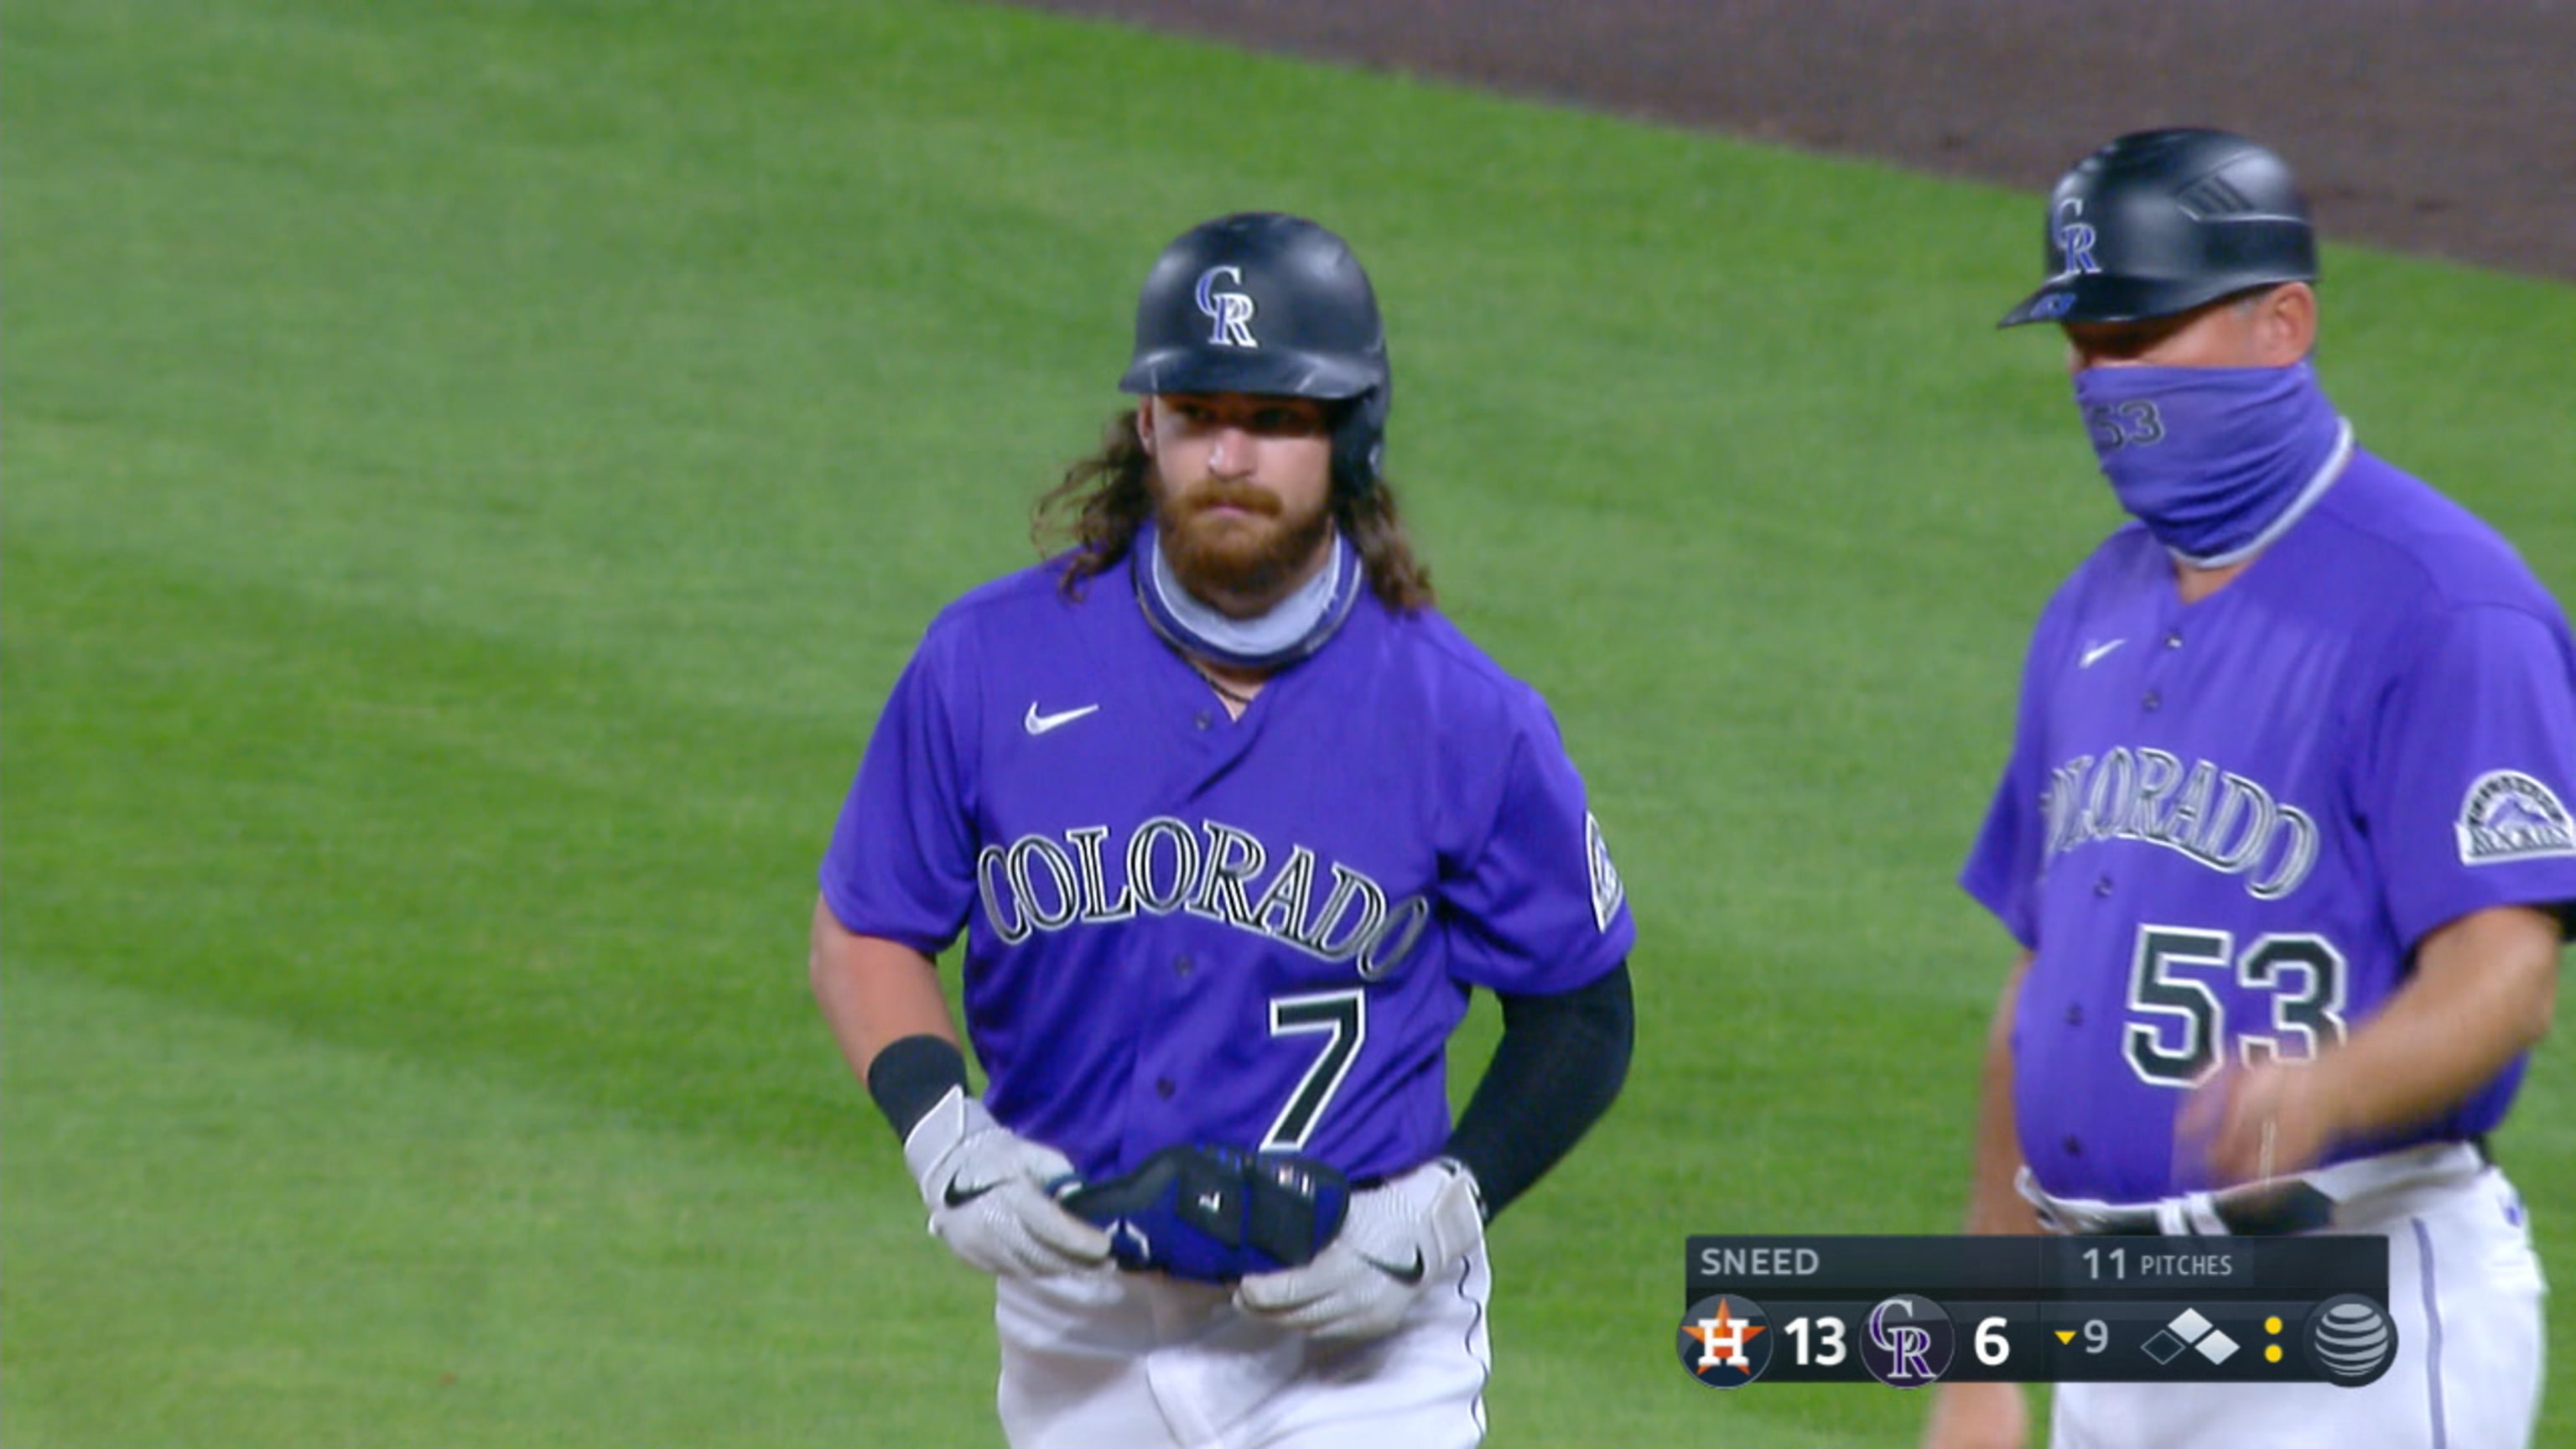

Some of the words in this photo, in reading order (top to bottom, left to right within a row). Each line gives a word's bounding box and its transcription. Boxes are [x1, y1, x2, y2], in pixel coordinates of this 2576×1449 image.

[1195, 265, 1257, 348] CR
[978, 816, 1429, 982] COLORADO
[2041, 745, 2319, 901] OLORADO
[1258, 988, 1367, 1154] 7
[2122, 924, 2347, 1088] 53
